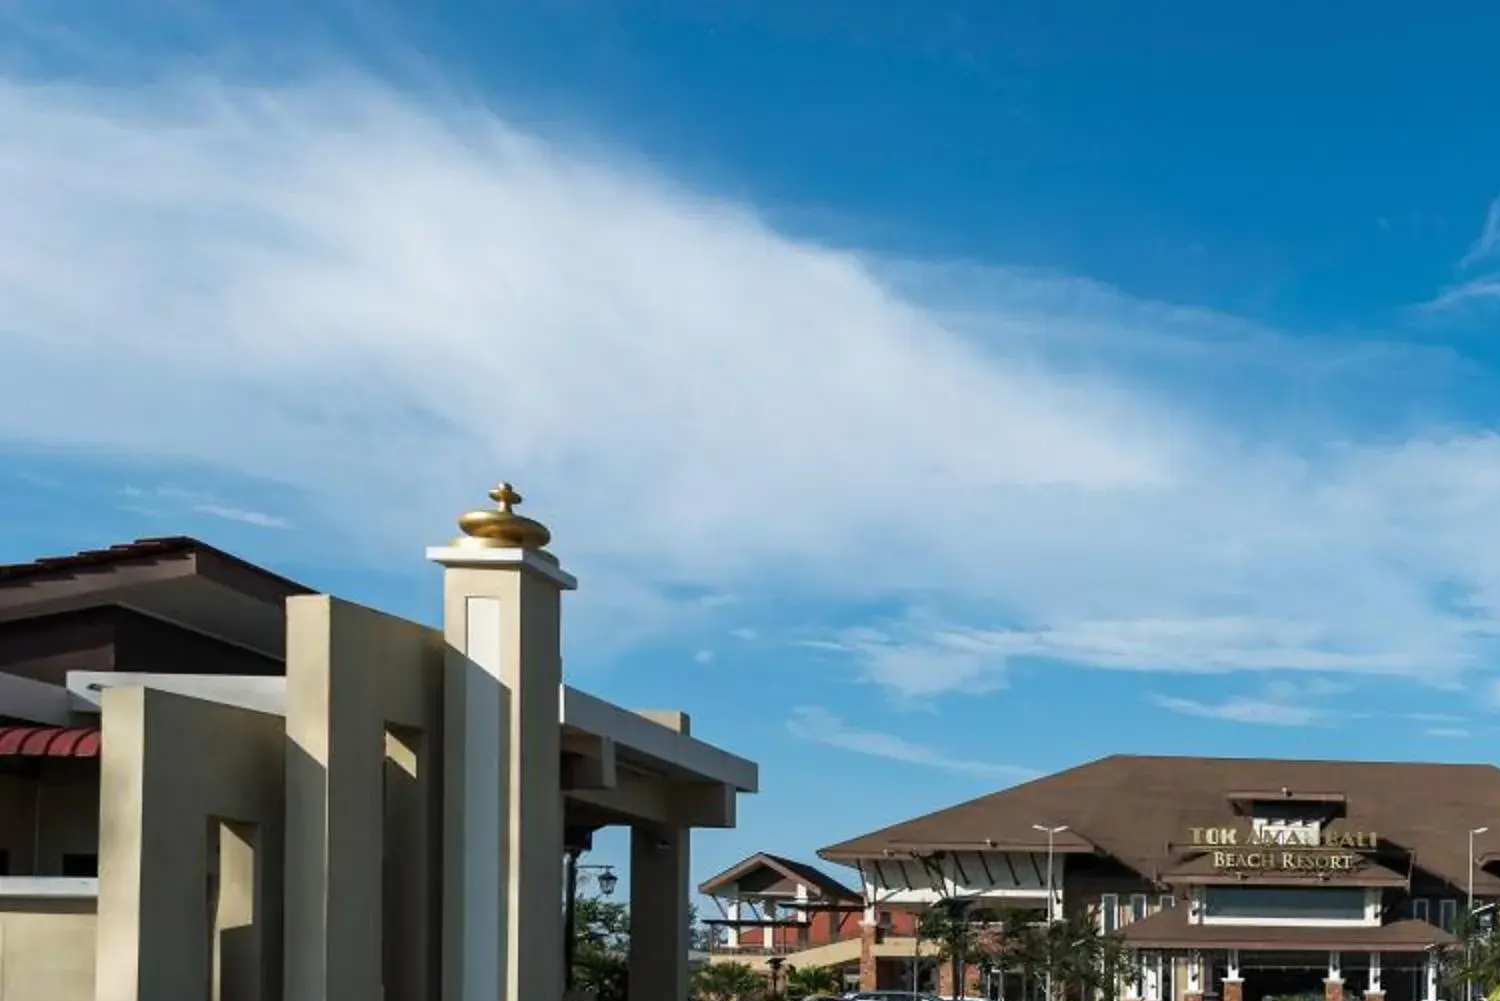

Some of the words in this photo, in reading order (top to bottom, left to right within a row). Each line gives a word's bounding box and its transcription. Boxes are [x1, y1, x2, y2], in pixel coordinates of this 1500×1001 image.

[1189, 827, 1237, 845] TOK
[1213, 851, 1276, 868] BEACH
[1282, 851, 1353, 869] RESORT
